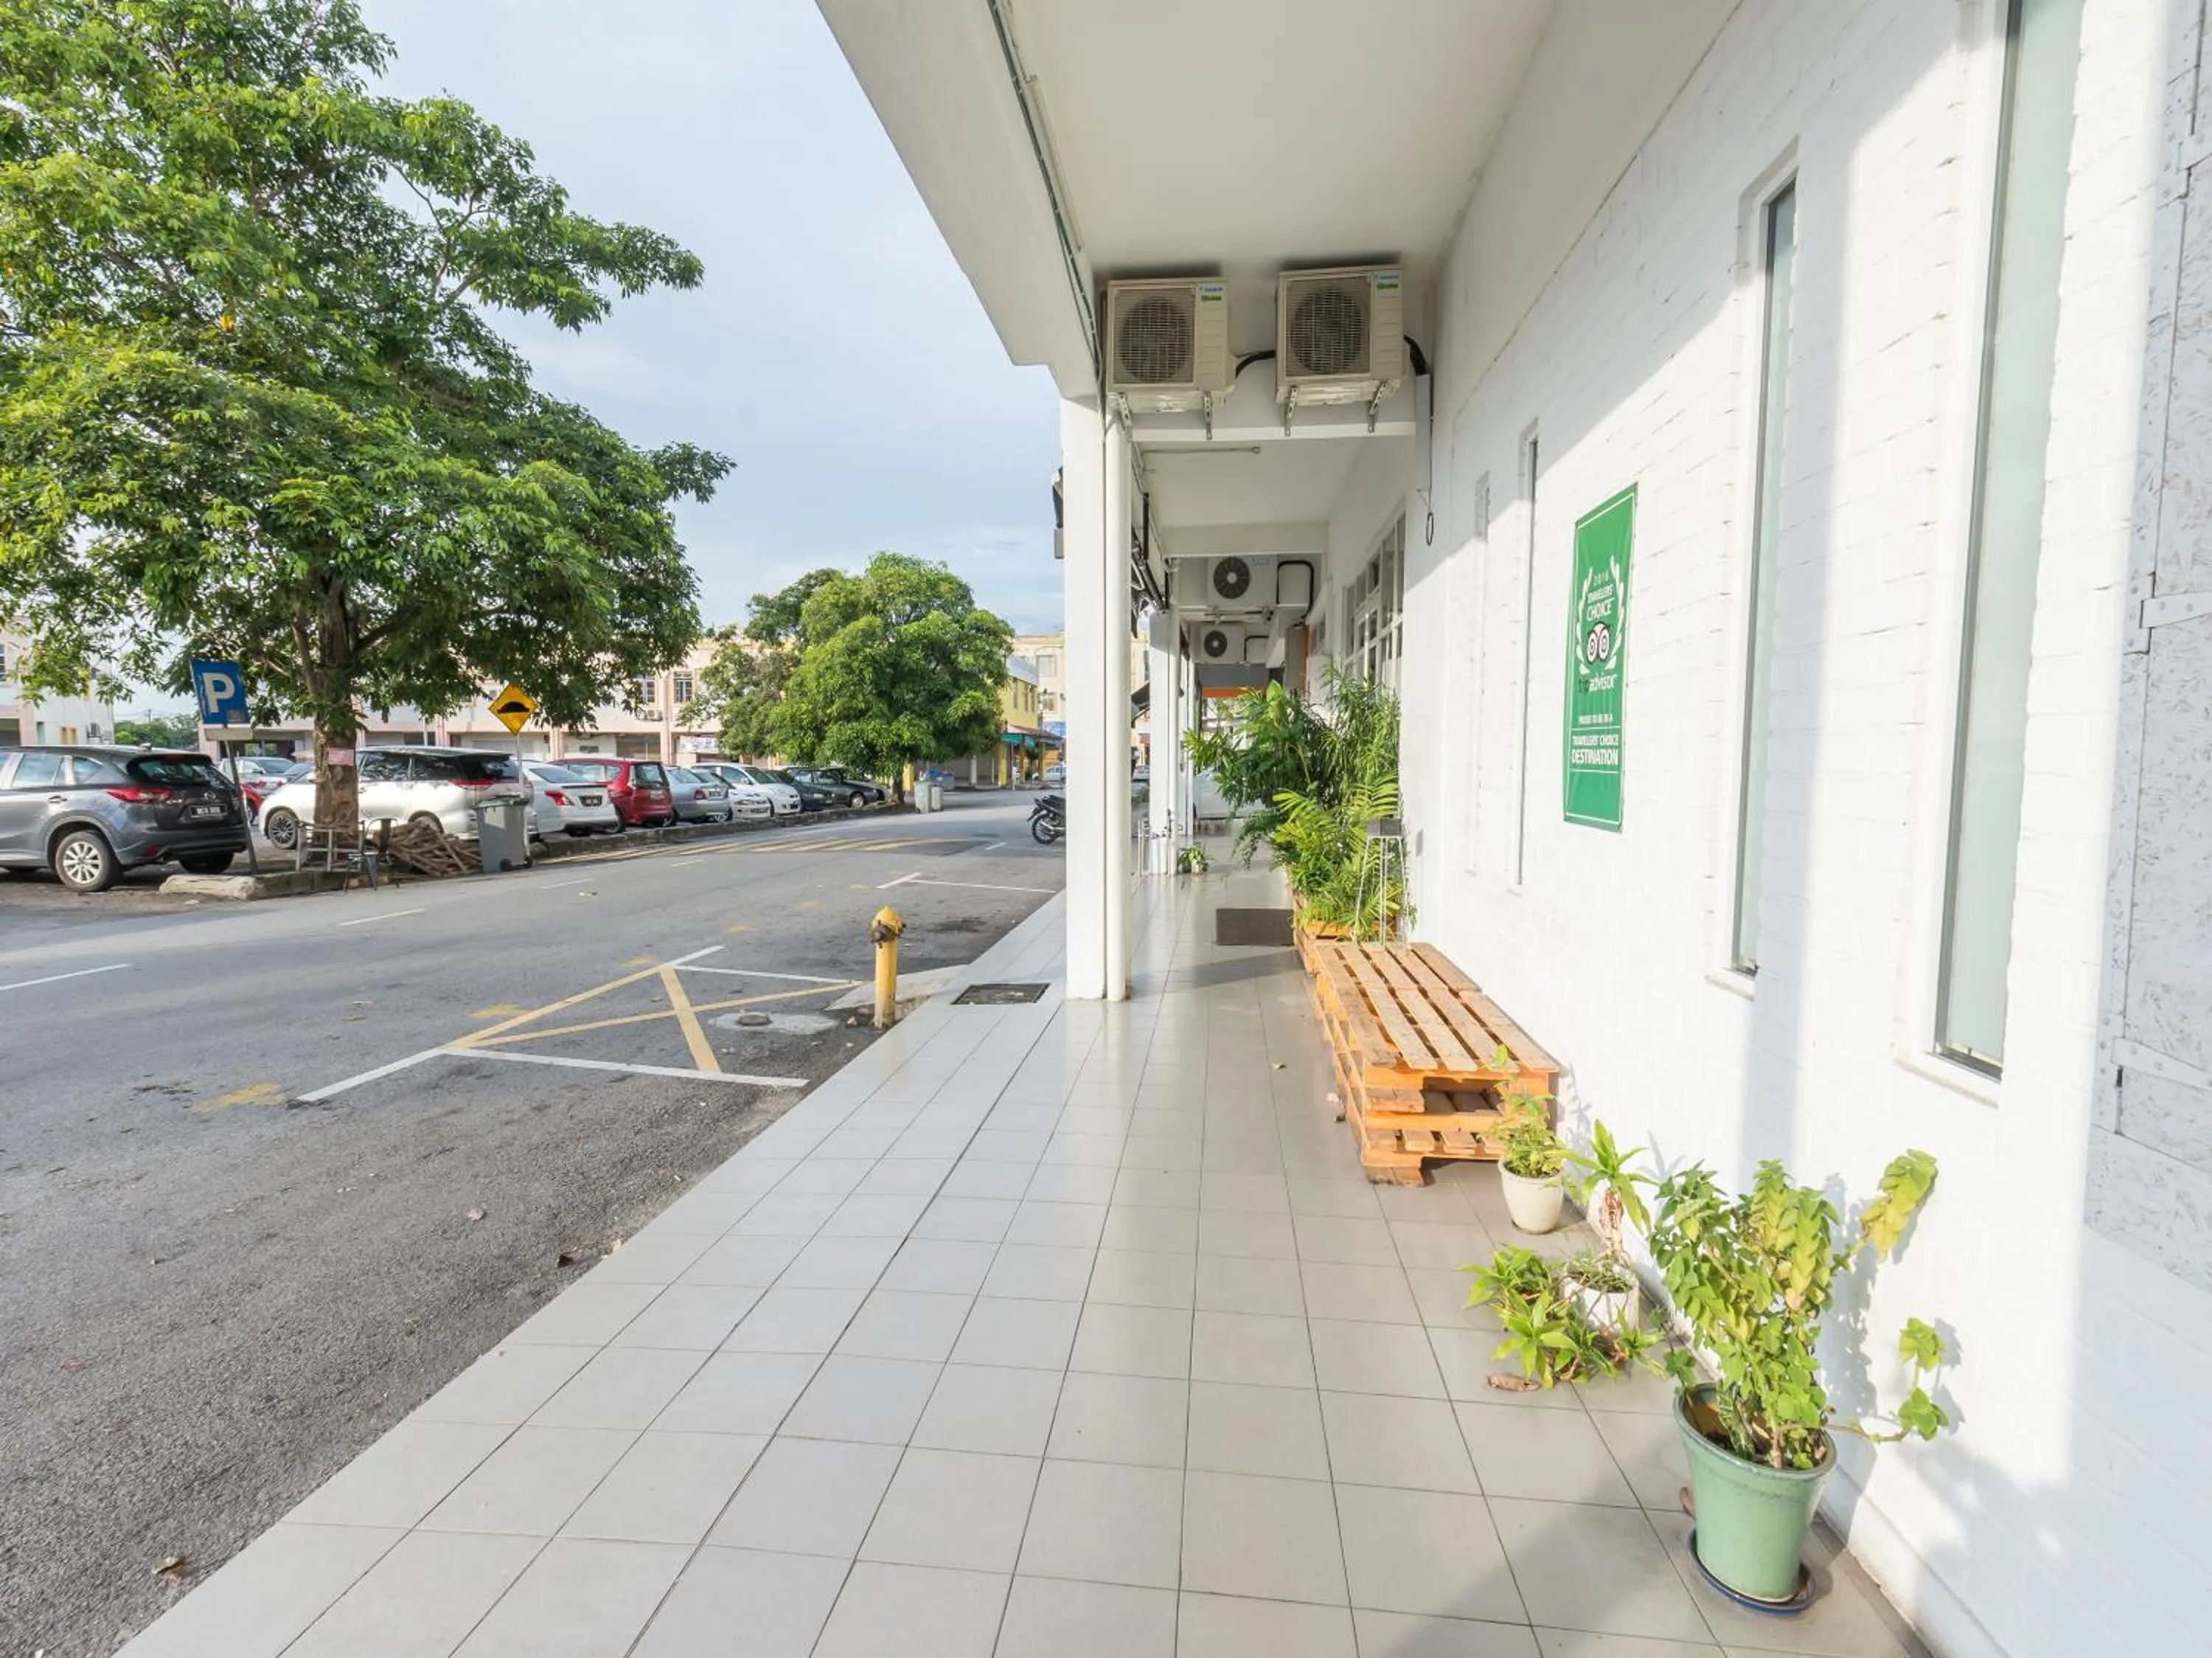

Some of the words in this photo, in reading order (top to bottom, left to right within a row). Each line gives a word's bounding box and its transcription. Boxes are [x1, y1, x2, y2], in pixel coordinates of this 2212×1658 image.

[1587, 600, 1612, 620] CHOICE
[202, 672, 235, 713] P
[1599, 735, 1618, 746] CHOICE
[1571, 749, 1618, 766] DESTINATION
